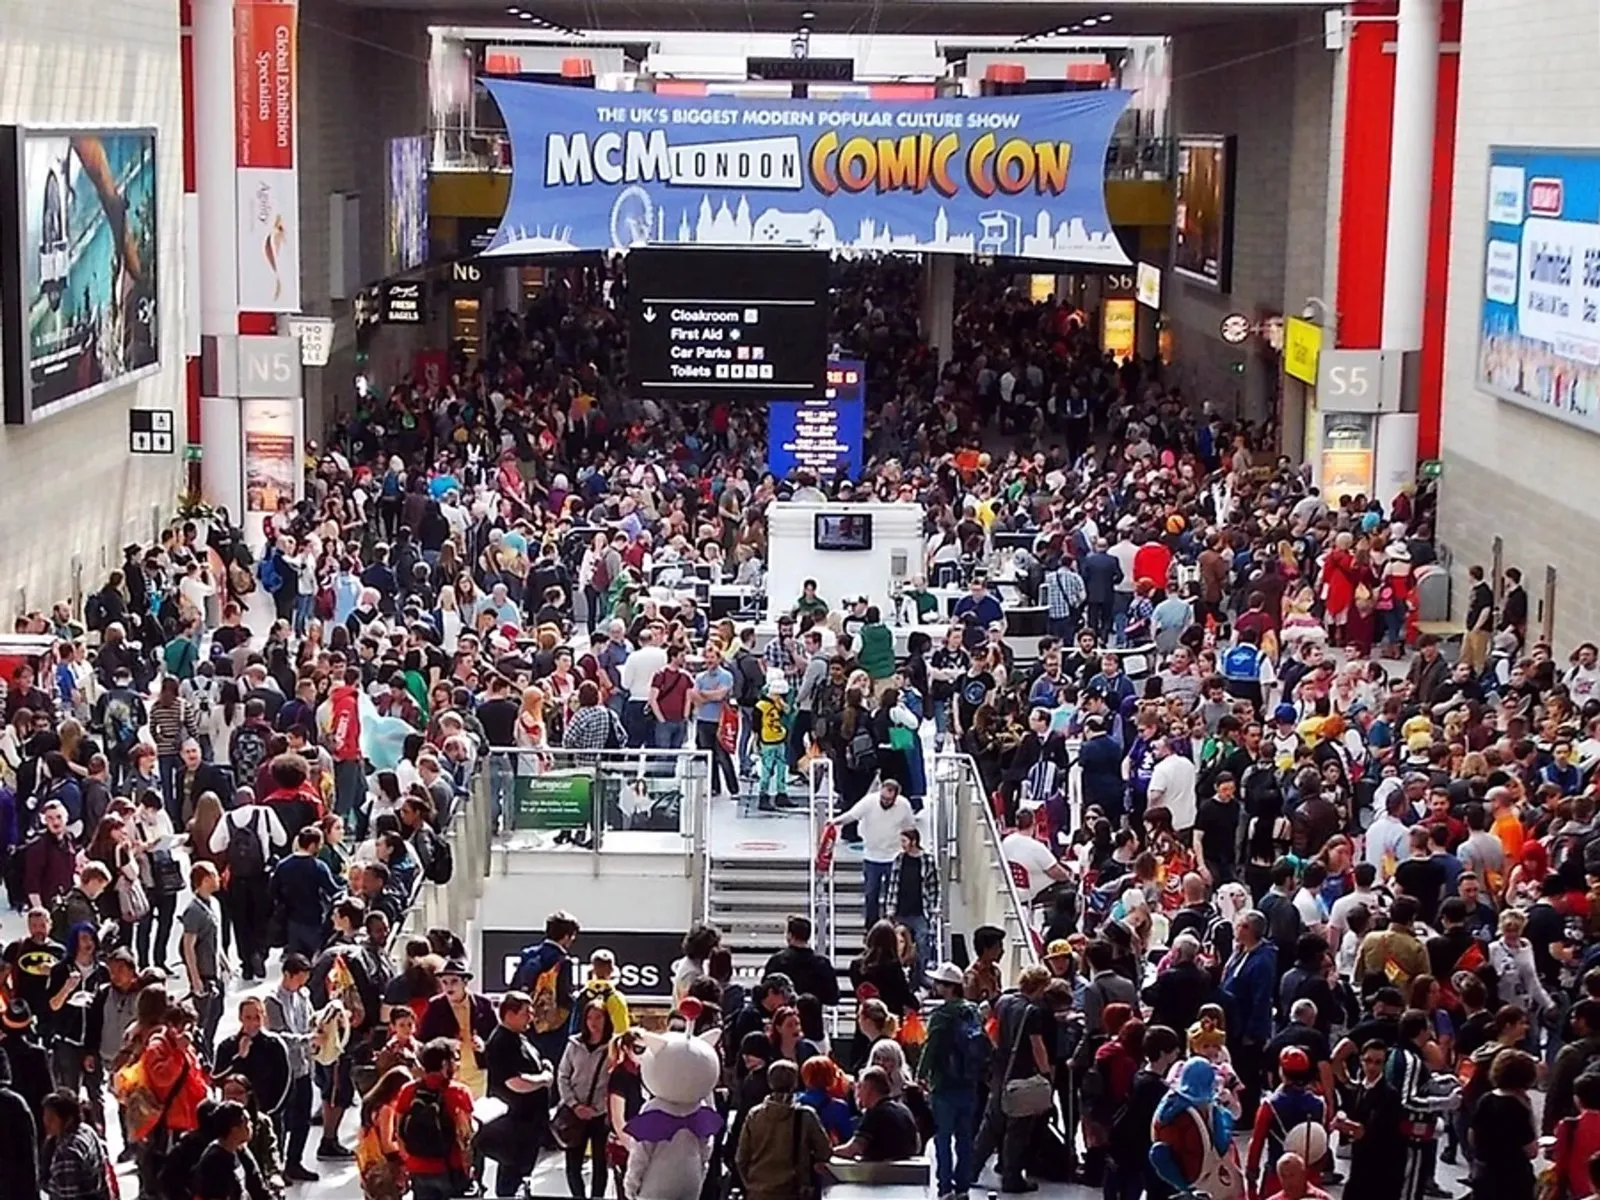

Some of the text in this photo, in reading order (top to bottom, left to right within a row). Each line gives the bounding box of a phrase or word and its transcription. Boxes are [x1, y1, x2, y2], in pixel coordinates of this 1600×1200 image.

[256, 51, 271, 121] Specialists
[276, 25, 289, 147] Global Exhibition
[597, 107, 1020, 129] THE UK'S BIGGEST MODERN POPULAR CULTURE SHOW
[544, 129, 1072, 198] MCM LONDON COMIC CON
[453, 262, 481, 281] N6
[1108, 274, 1131, 291] S6
[670, 308, 739, 322] Cloakroom
[670, 328, 723, 341] First Aid
[670, 347, 732, 359] Car Parks
[247, 354, 292, 382] N5
[670, 364, 712, 377] Toilets
[1328, 366, 1368, 396] S5
[530, 780, 573, 791] Europcar
